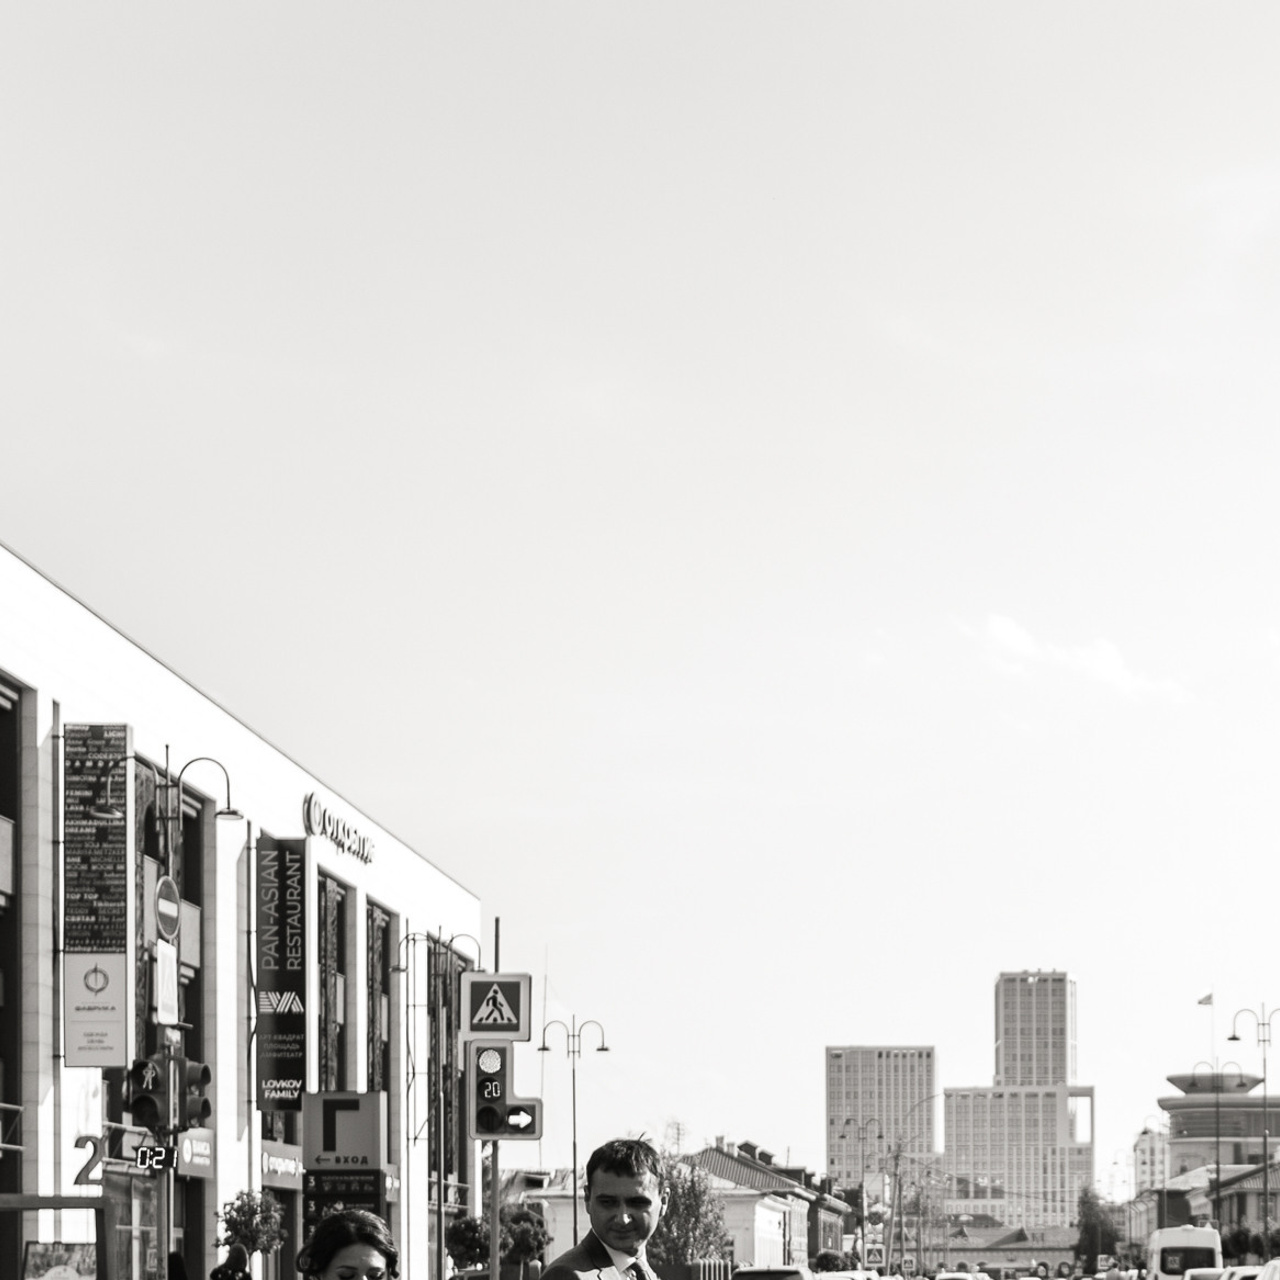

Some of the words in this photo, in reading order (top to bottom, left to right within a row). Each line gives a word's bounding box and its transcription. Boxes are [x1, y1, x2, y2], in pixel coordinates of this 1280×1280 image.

[261, 850, 280, 970] PAN-ASIAN
[286, 851, 302, 971] RESTAURANT
[262, 1080, 302, 1089] LOVKOV
[484, 1081, 501, 1098] 20
[264, 1090, 300, 1099] FAMILY
[74, 1135, 105, 1186] 2
[137, 1146, 178, 1169] 0:21
[335, 1155, 369, 1165] ВХОД
[308, 1175, 316, 1187] 3
[308, 1200, 316, 1212] 3
